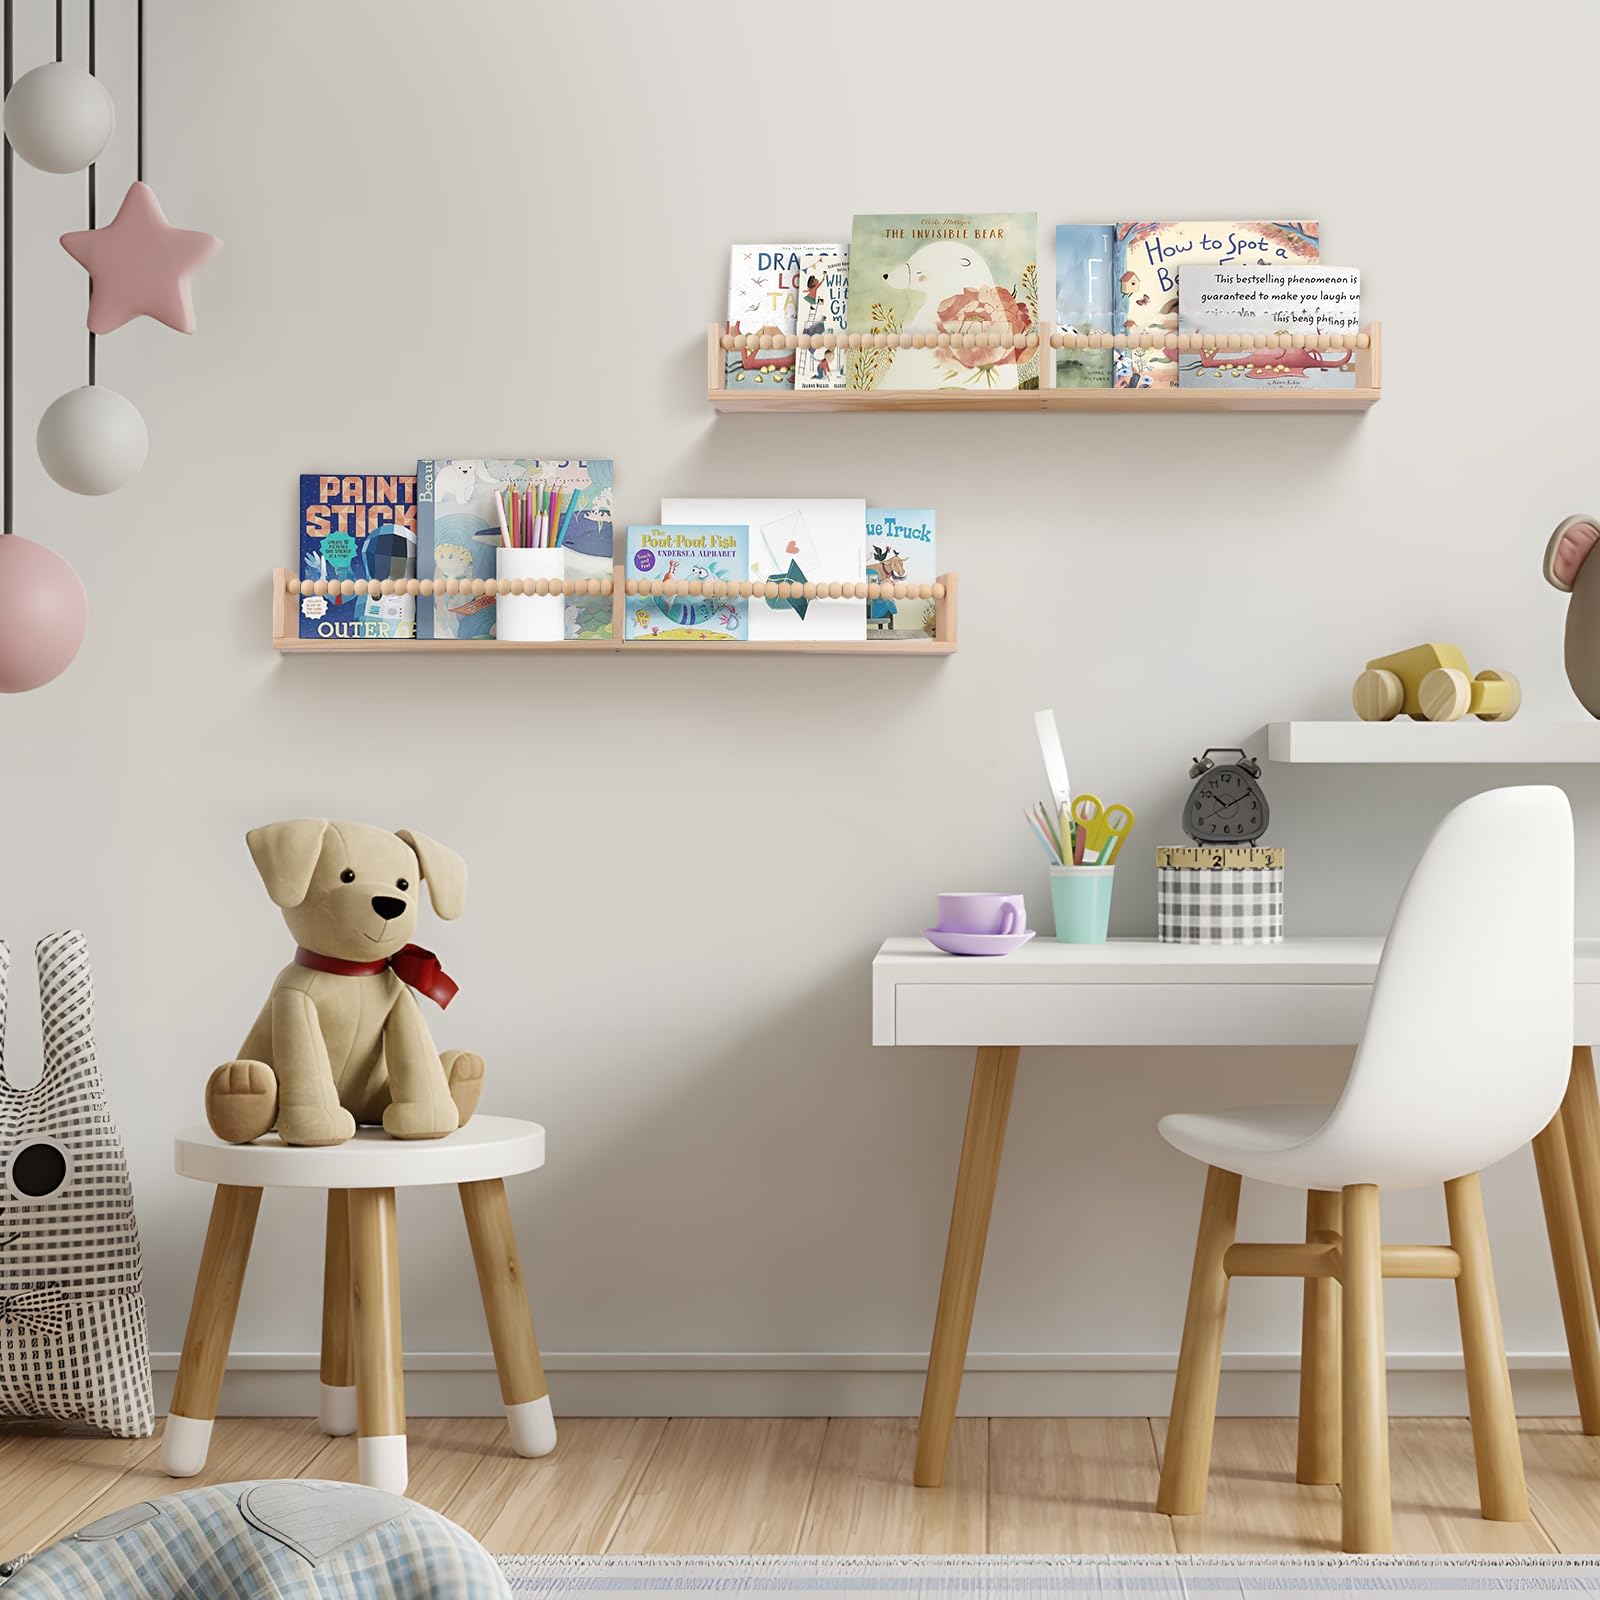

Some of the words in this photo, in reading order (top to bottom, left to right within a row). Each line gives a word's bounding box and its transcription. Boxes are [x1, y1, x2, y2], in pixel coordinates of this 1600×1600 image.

[885, 228, 905, 239] THE
[912, 228, 968, 239] INVISIBLE
[974, 228, 1004, 239] BEAR
[1145, 237, 1193, 266] How
[1200, 234, 1222, 250] to
[1226, 233, 1269, 255] Spot
[1275, 248, 1288, 259] a
[1214, 274, 1233, 284] This
[1236, 273, 1285, 286] bestselling
[1287, 274, 1348, 286] phenomenon
[1350, 274, 1358, 284] is
[1201, 291, 1256, 303] guaranteed
[1259, 292, 1269, 300] to
[1271, 291, 1298, 301] make
[1300, 293, 1318, 304] you
[1320, 290, 1347, 303] laugh
[1273, 312, 1290, 322] This
[320, 476, 417, 504] PAINT
[306, 505, 417, 538] STICK
[651, 528, 665, 537] The
[866, 523, 883, 536] ue
[884, 517, 931, 542] Truck
[641, 534, 707, 548] Pout-Pout
[710, 534, 737, 549] Fish
[658, 550, 696, 558] UNDERSEA
[697, 550, 737, 558] ALPHABET
[317, 621, 391, 639] OUTER
[1212, 855, 1222, 867] 2
